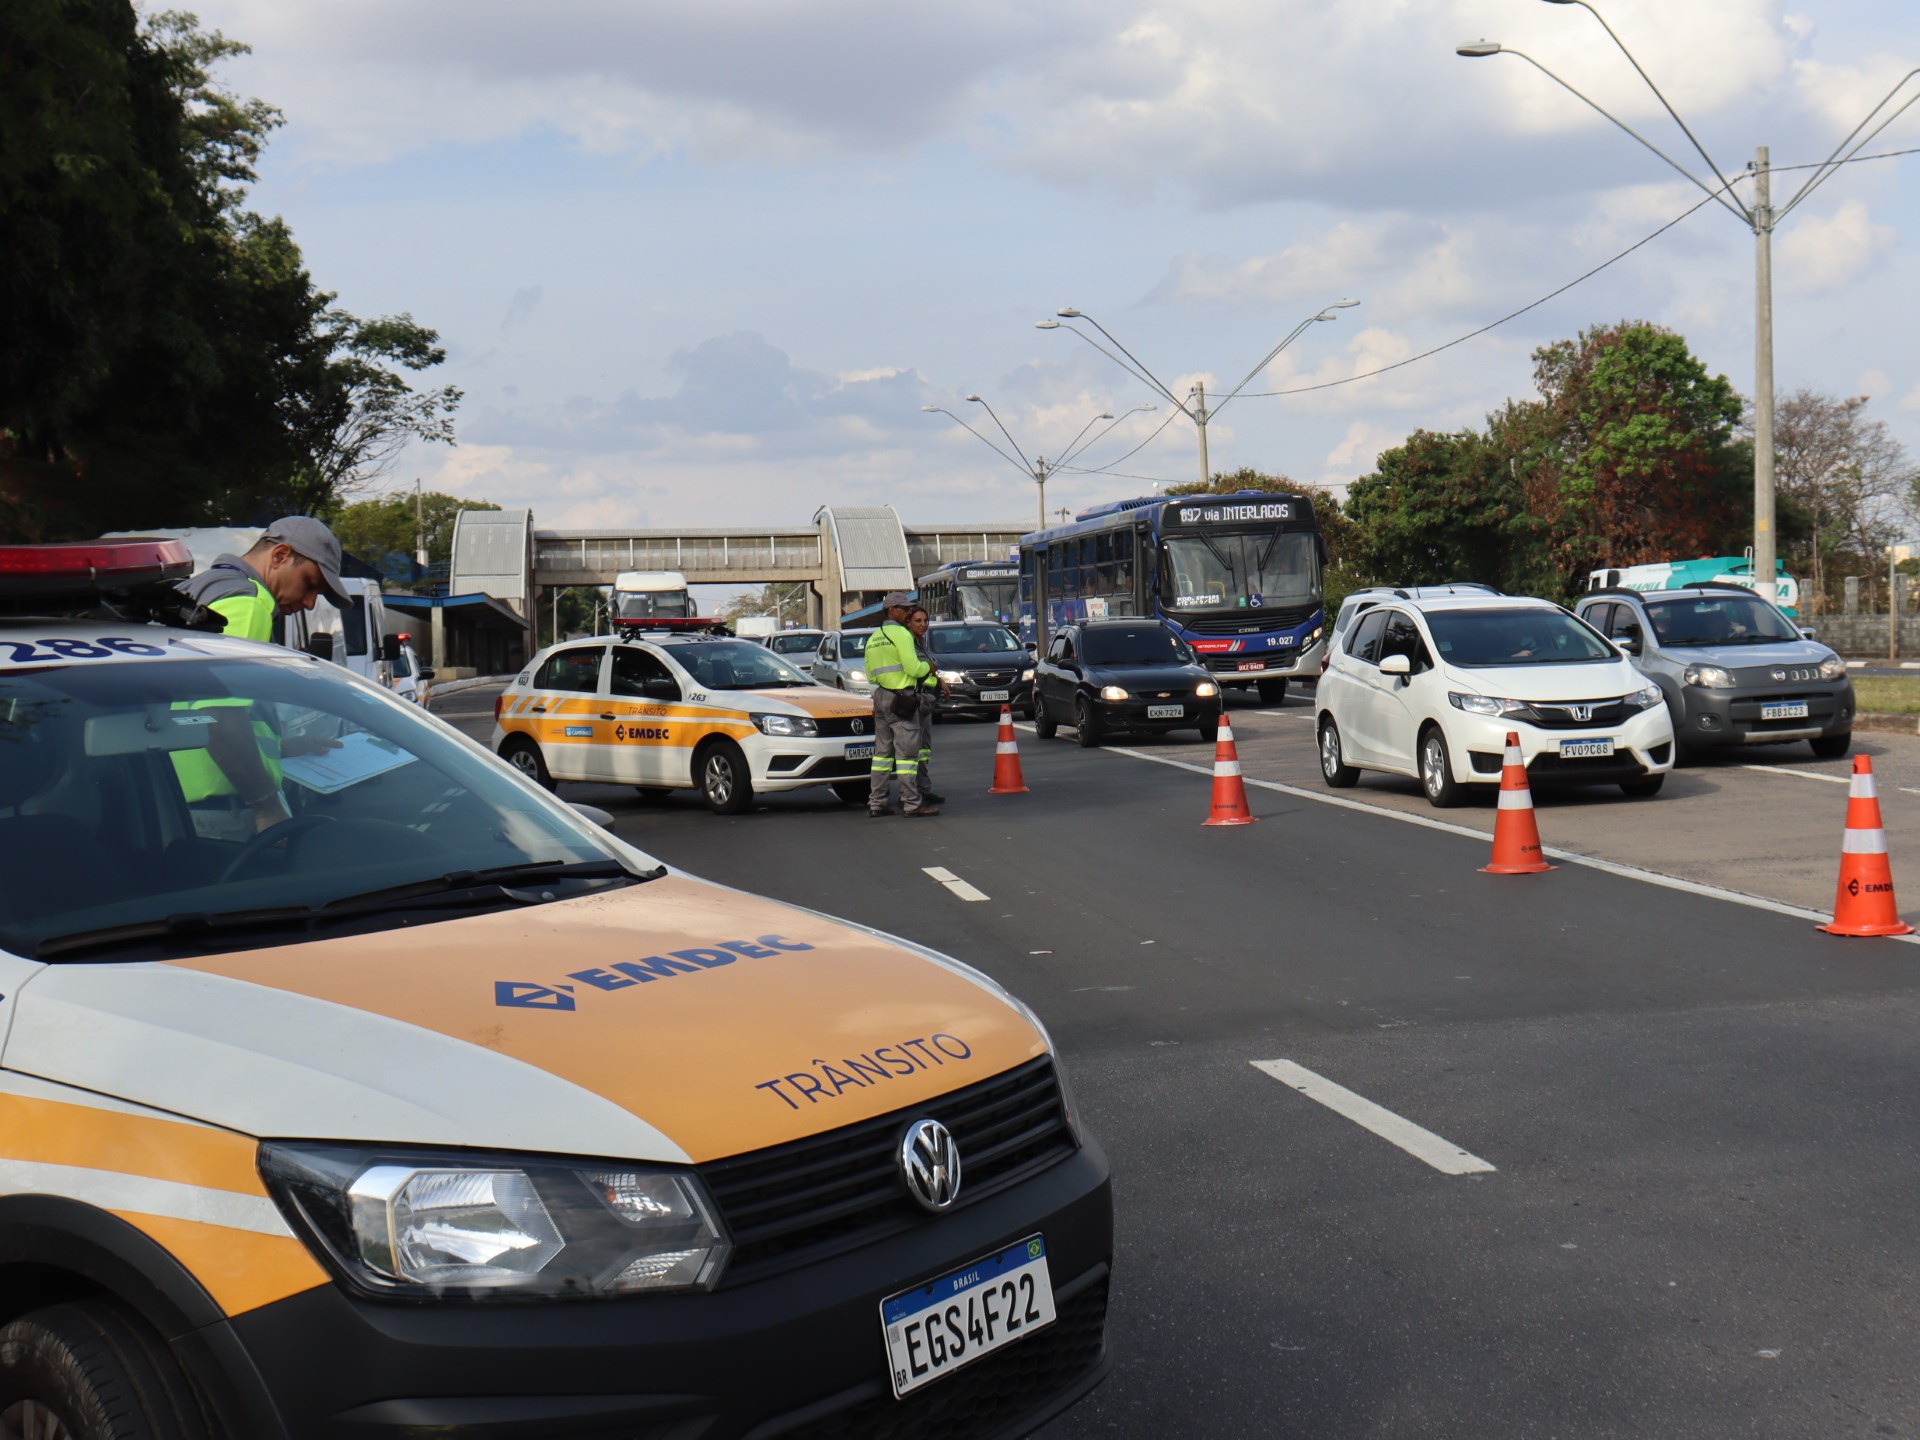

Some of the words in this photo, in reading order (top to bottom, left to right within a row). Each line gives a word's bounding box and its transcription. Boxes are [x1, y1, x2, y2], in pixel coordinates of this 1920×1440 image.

[1180, 508, 1201, 522] 697
[1204, 510, 1220, 521] via
[1222, 504, 1289, 521] INTERLAGOS
[0, 637, 166, 662] 286
[1266, 636, 1294, 646] 19.027
[691, 693, 707, 702] 263
[1766, 706, 1804, 718] FBB1C23
[629, 728, 669, 740] EMDEC
[566, 934, 816, 991] EMDEC
[754, 1033, 972, 1110] TRÂNSITO
[953, 1271, 980, 1291] BRASIL
[903, 1272, 1040, 1379] EGS4F22
[897, 1369, 909, 1388] BR
